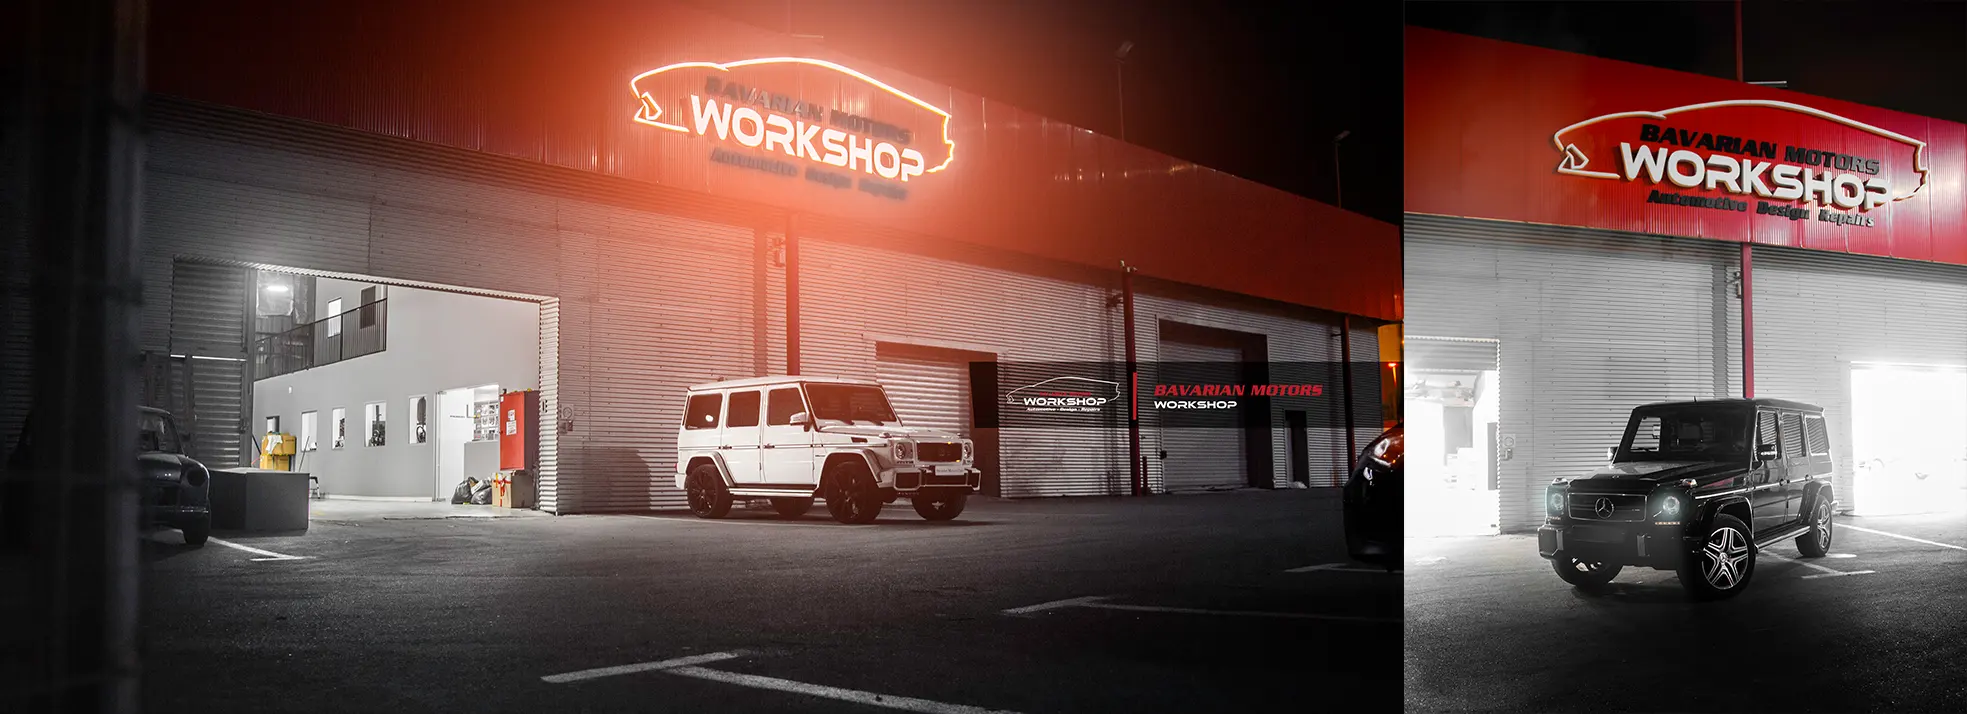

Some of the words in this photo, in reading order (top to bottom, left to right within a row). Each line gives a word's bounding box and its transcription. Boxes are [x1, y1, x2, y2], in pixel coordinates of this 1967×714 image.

[705, 76, 824, 123] BAVARIAN
[690, 94, 926, 183] WORKSHOP
[1639, 123, 1778, 161] BAVARIAN
[1784, 145, 1881, 176] MOTORS
[1619, 141, 1895, 212] WORKSHOP
[1646, 189, 1749, 213] Automotive
[1756, 202, 1810, 221] Design
[1818, 209, 1875, 228] Repairs
